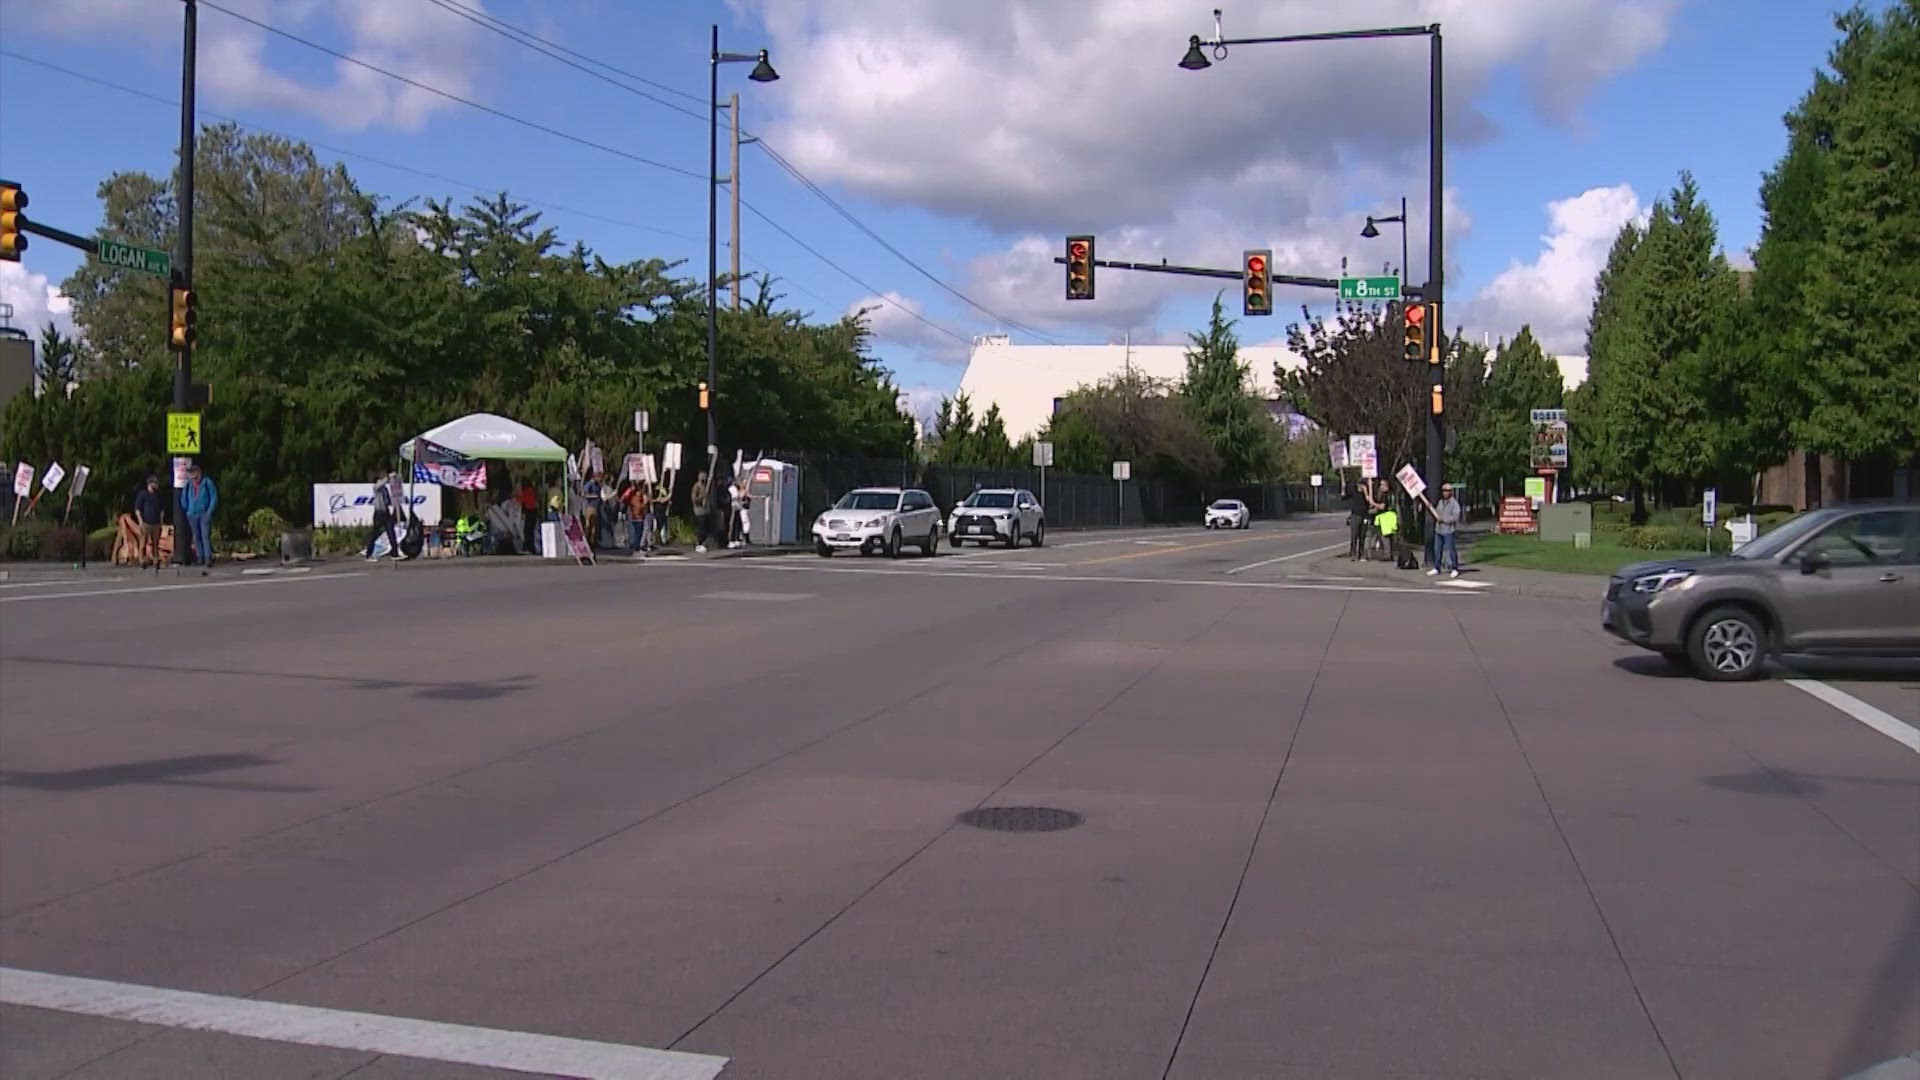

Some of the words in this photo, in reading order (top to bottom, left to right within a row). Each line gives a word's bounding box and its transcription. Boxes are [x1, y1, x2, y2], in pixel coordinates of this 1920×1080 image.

[100, 243, 146, 269] LOGAN
[1344, 287, 1353, 296] N
[1356, 280, 1381, 297] 8TH
[1383, 287, 1395, 296] ST
